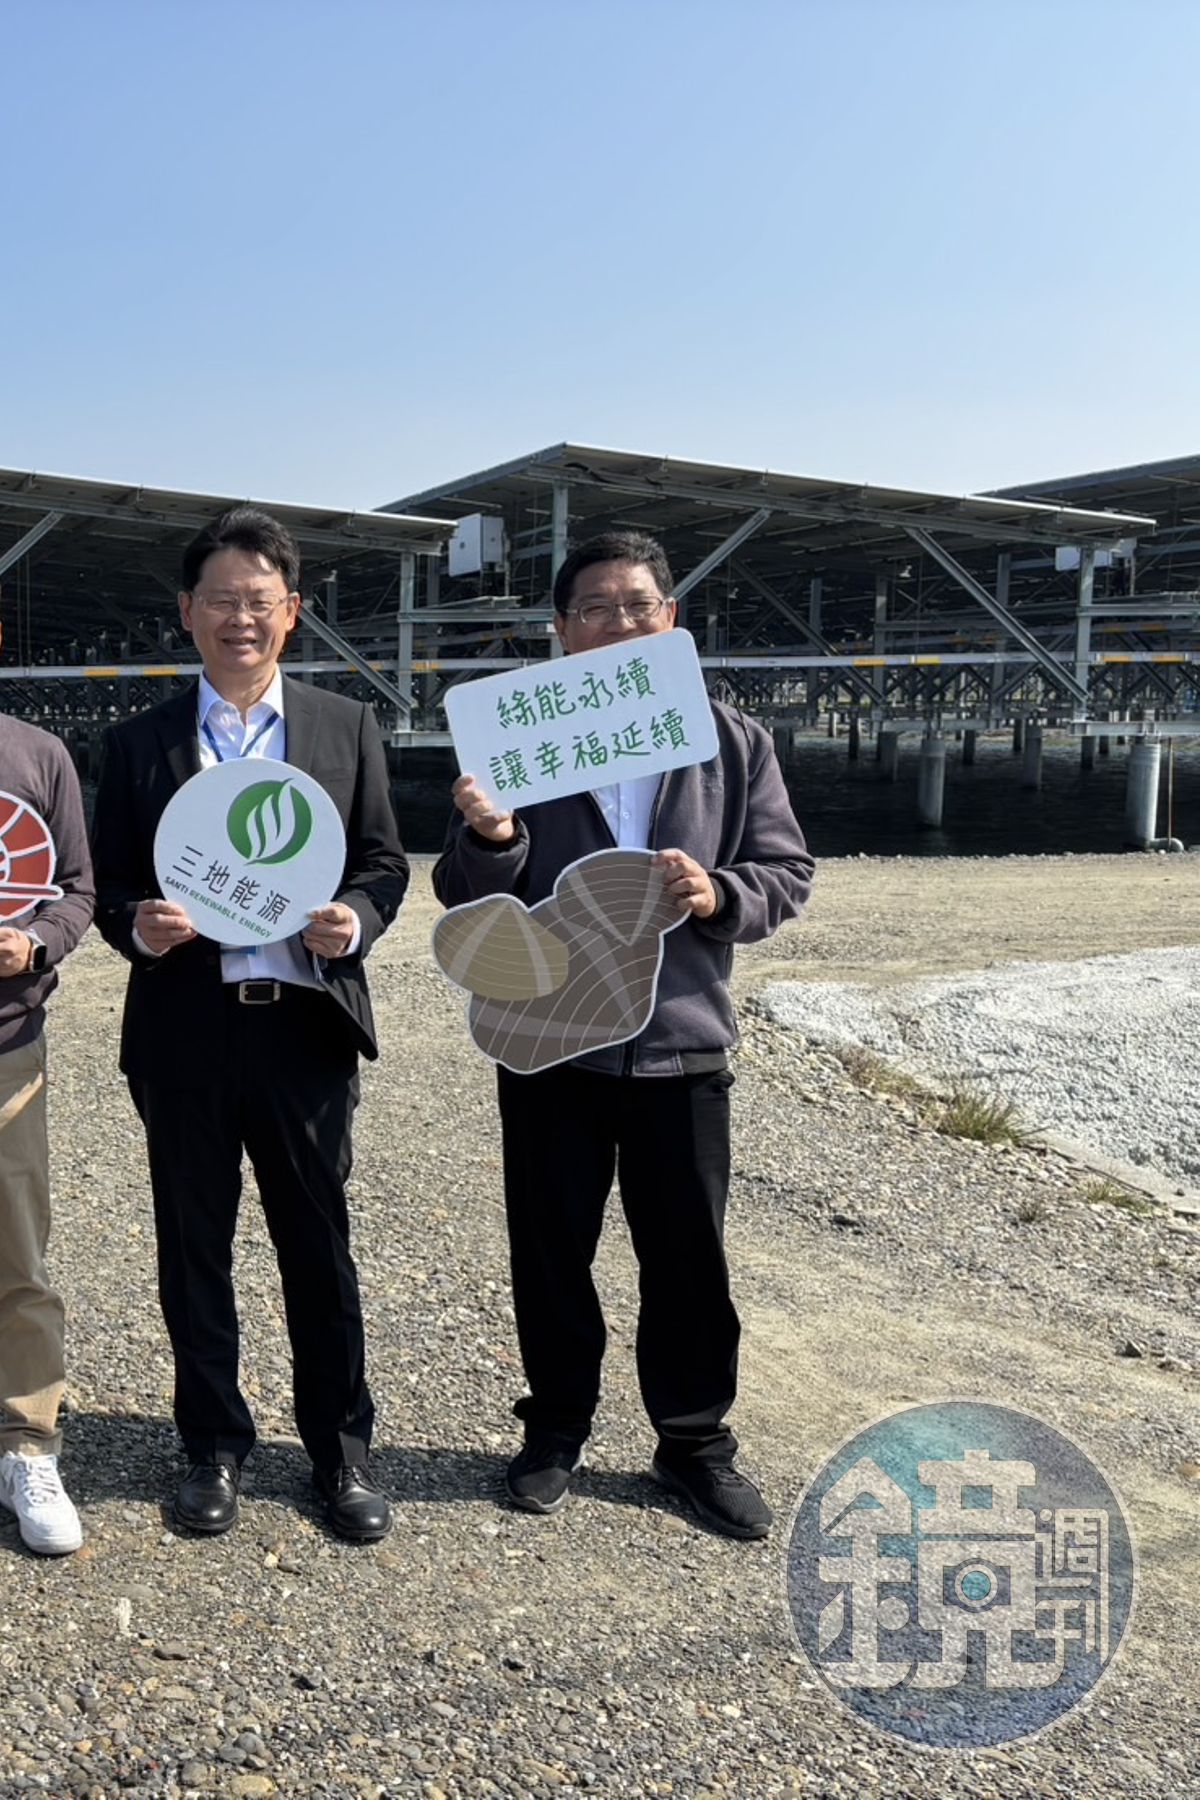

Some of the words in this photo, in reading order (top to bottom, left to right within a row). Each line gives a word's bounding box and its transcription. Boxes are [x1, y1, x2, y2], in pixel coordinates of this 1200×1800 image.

[496, 656, 657, 729] 綠能永續
[489, 707, 691, 792] 讓幸福延續
[164, 876, 189, 894] SANTI
[189, 889, 238, 920] RENEWABLE
[239, 917, 273, 938] ENERGY
[172, 844, 291, 925] 三地能源
